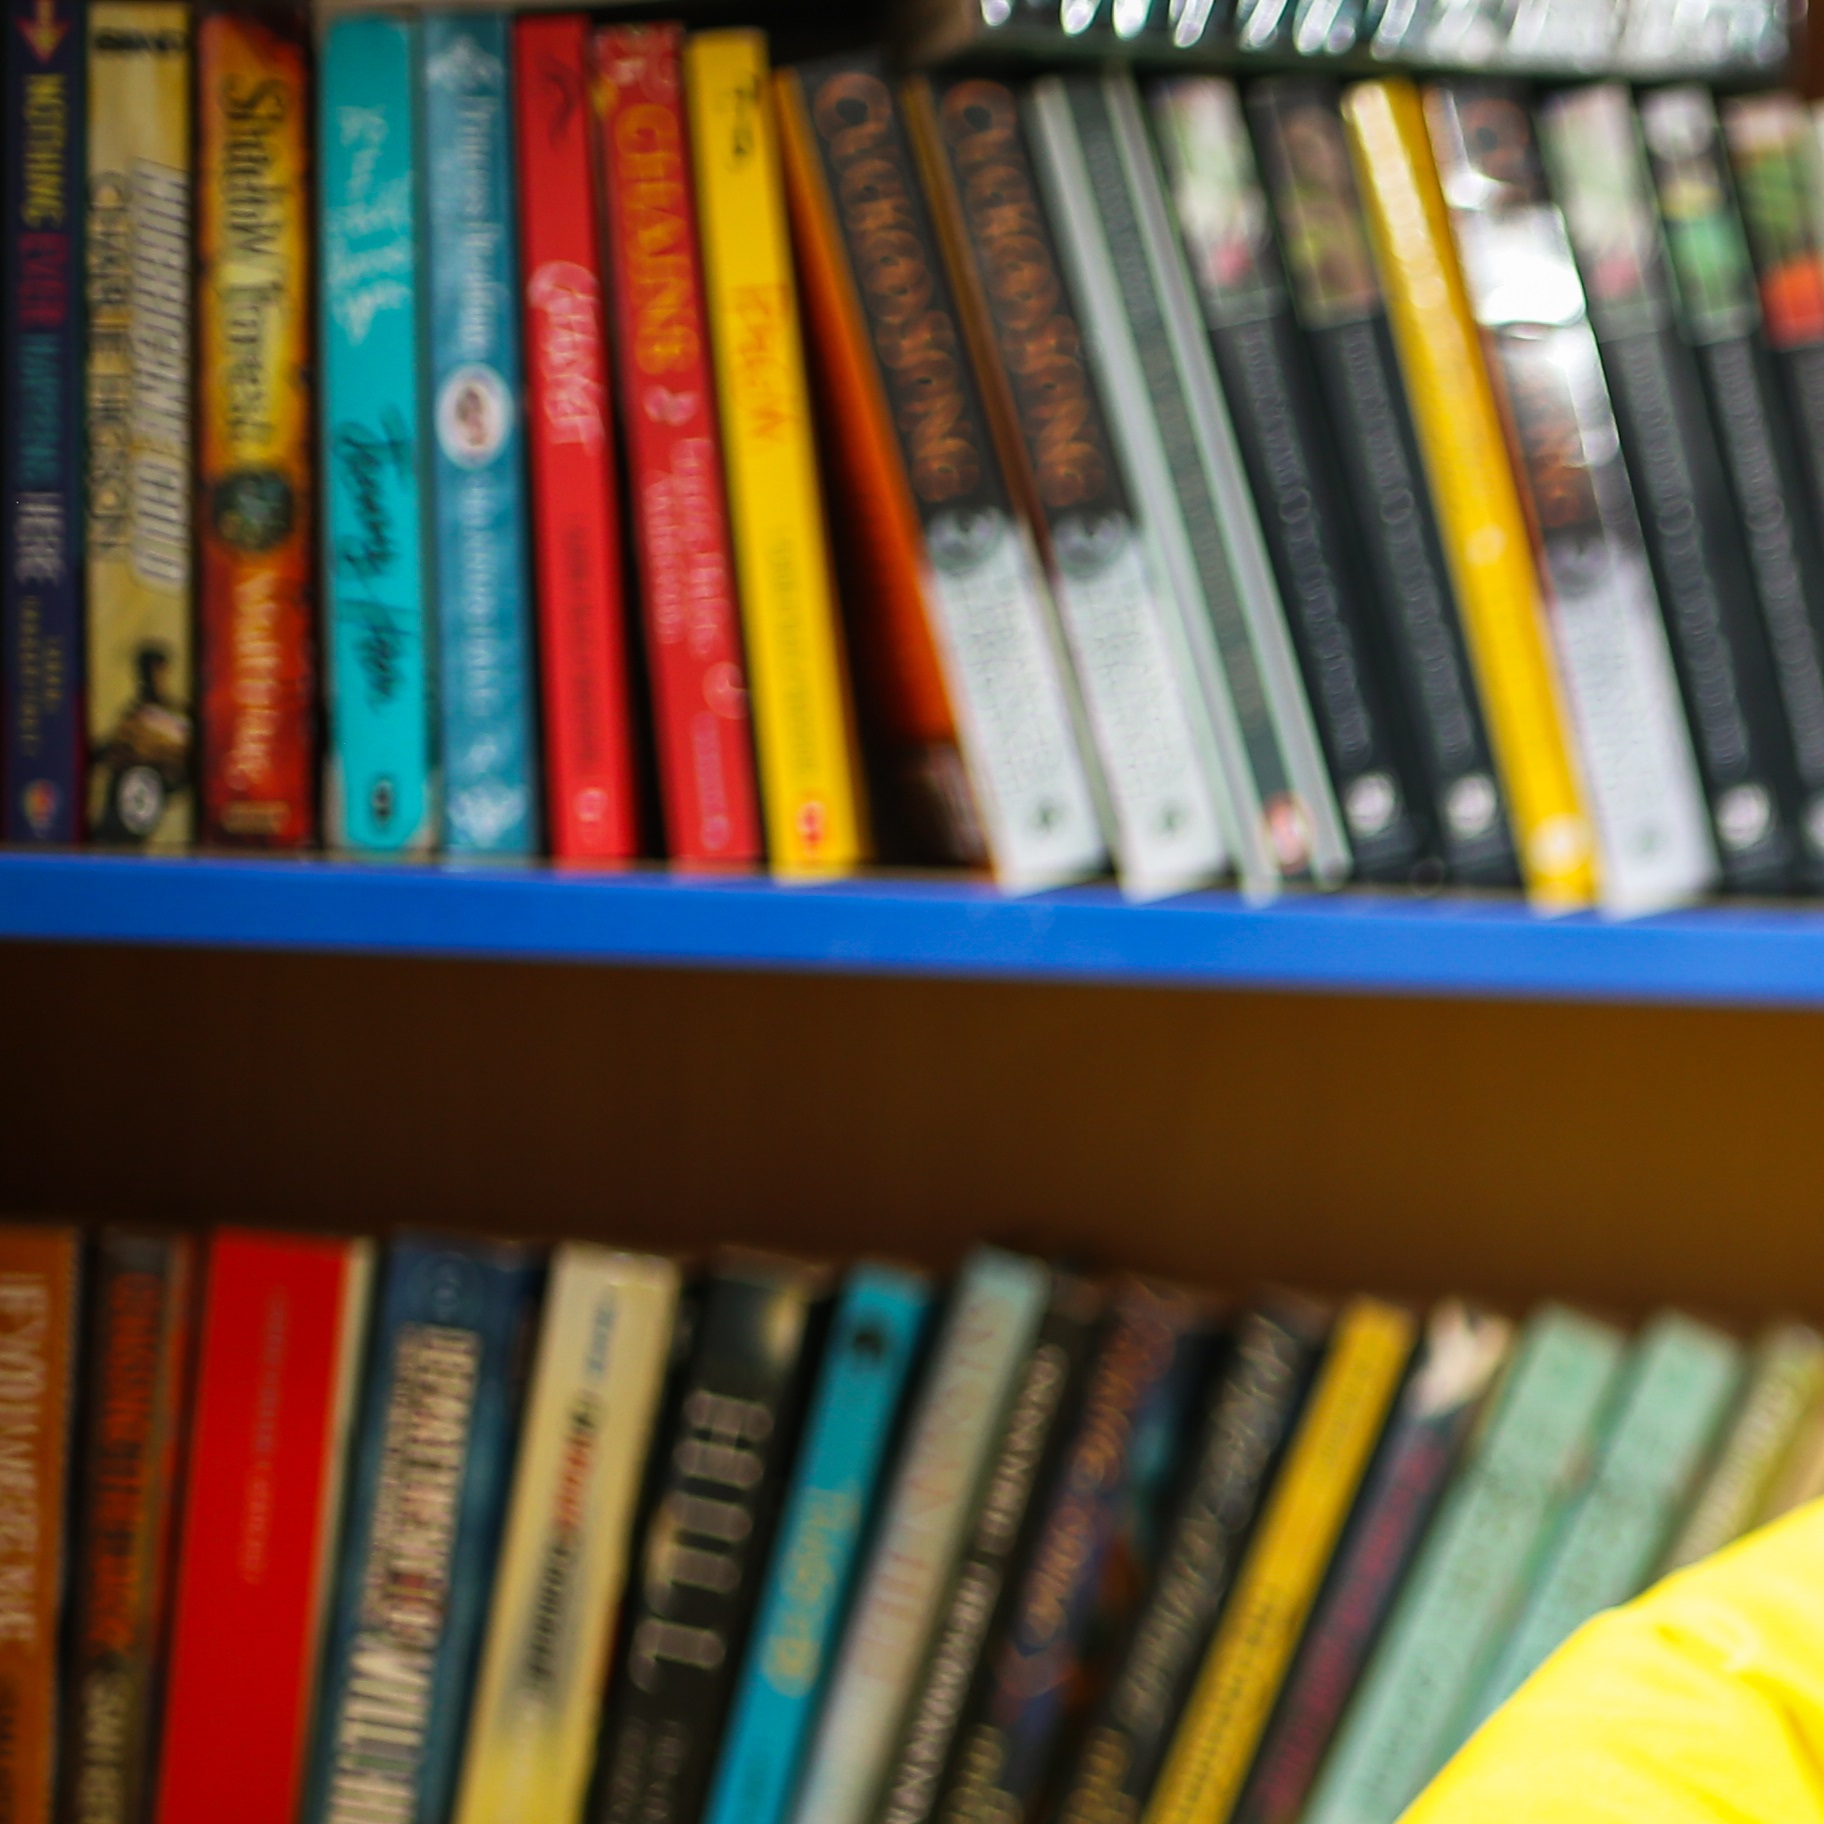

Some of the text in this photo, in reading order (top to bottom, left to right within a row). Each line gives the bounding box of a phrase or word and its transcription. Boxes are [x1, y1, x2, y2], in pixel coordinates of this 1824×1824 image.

[19, 73, 65, 229] NOTHING
[813, 73, 936, 320] CUCKOO
[940, 78, 1062, 328] CUCKOO
[16, 232, 63, 326] EVER
[609, 100, 700, 378] CHAINS
[12, 491, 61, 585] HERE
[336, 1638, 440, 1758] WILL
